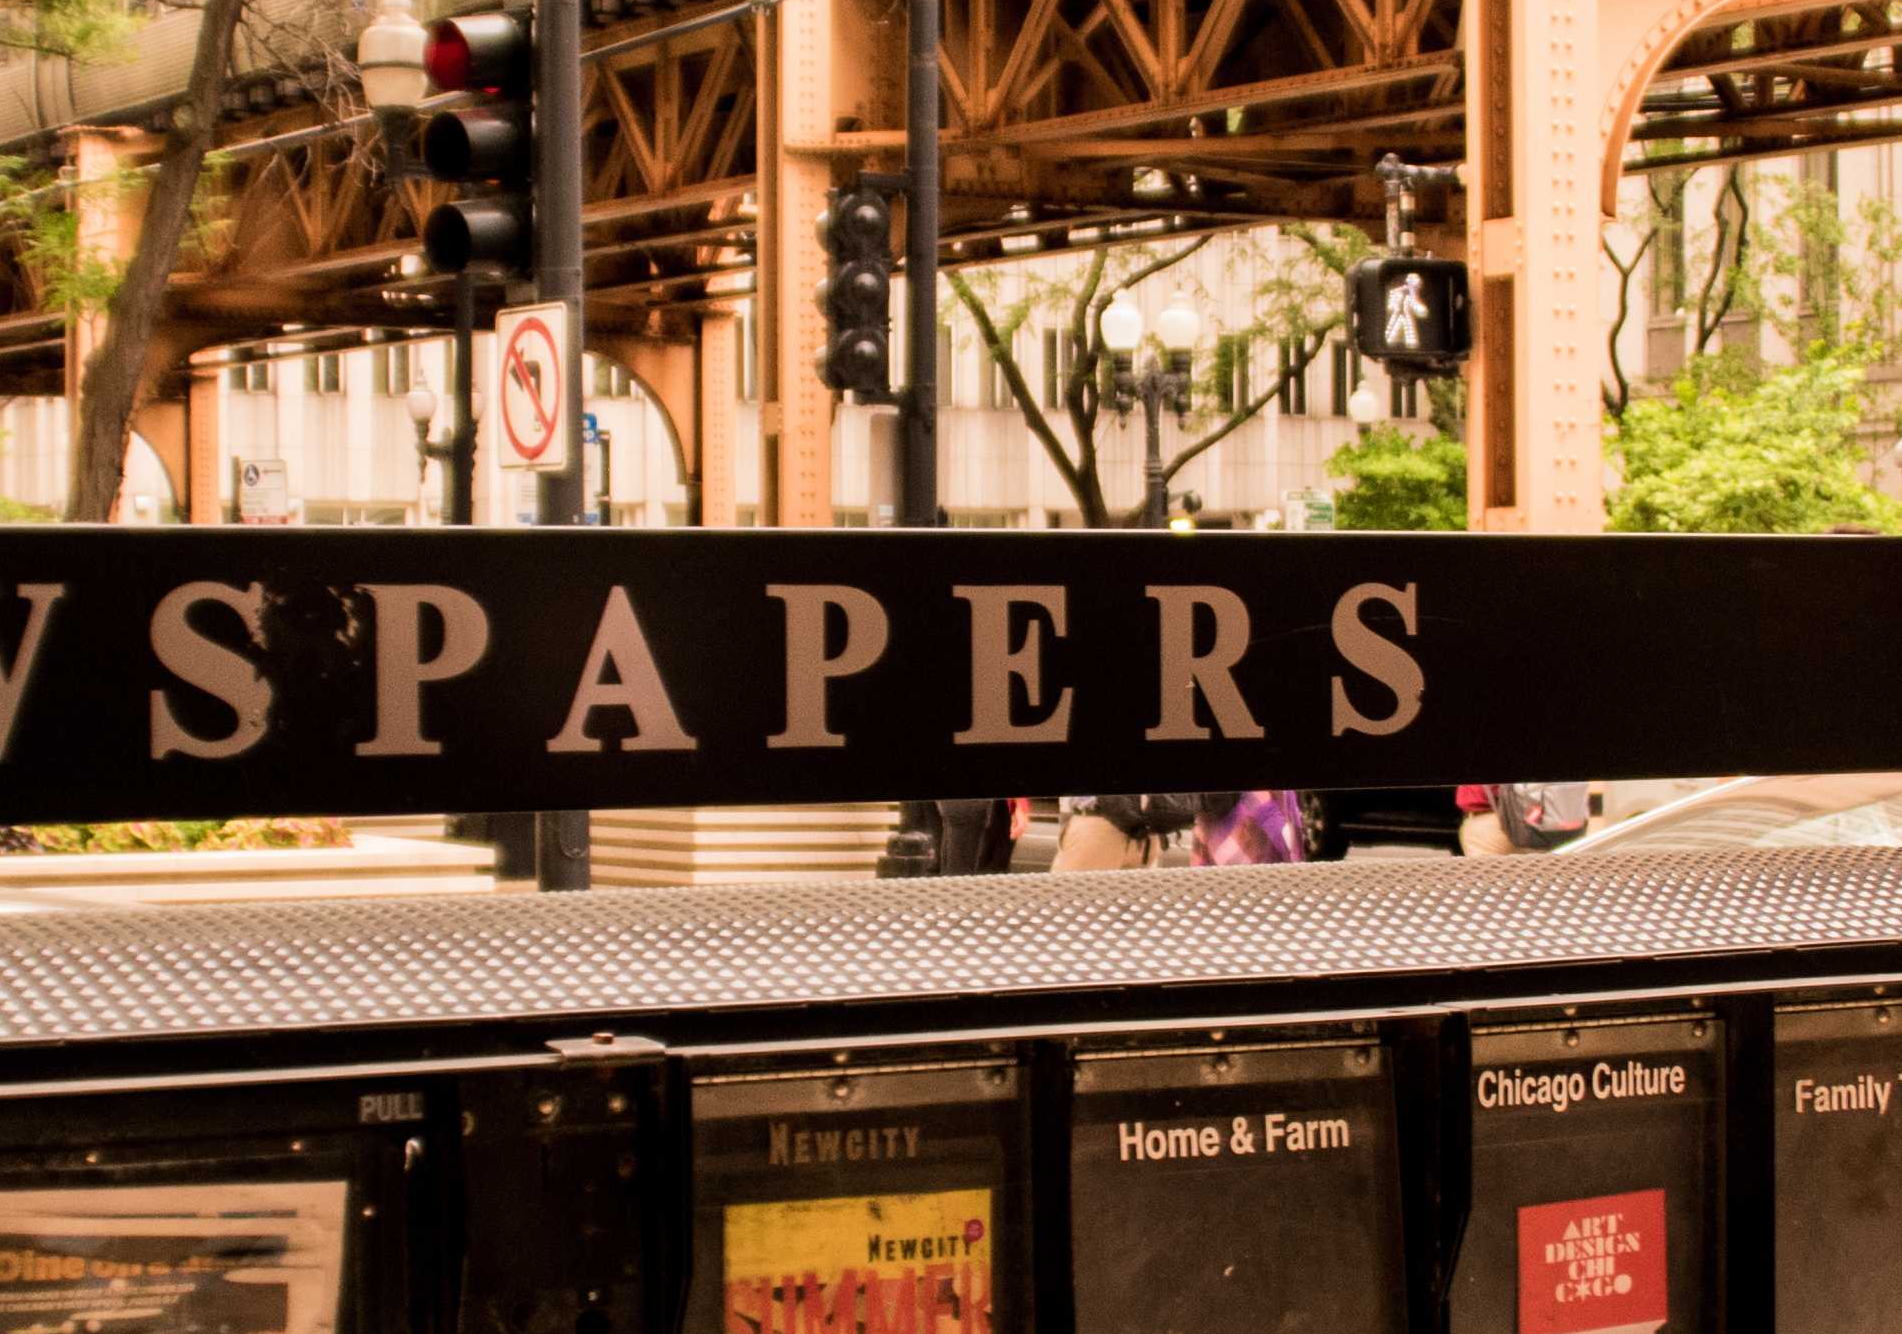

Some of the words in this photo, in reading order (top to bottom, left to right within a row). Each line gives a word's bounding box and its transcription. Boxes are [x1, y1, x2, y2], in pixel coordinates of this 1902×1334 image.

[1478, 1069, 1586, 1112] Chicago
[1592, 1060, 1685, 1099] Culture
[1795, 1075, 1892, 1115] Family
[359, 1092, 424, 1123] PULL
[1119, 1121, 1221, 1161] Home
[1230, 1116, 1256, 1154] &
[1265, 1113, 1350, 1152] Farm
[1563, 1213, 1624, 1241] ART
[1545, 1232, 1641, 1264] DESIGN
[1568, 1255, 1615, 1280] CHI
